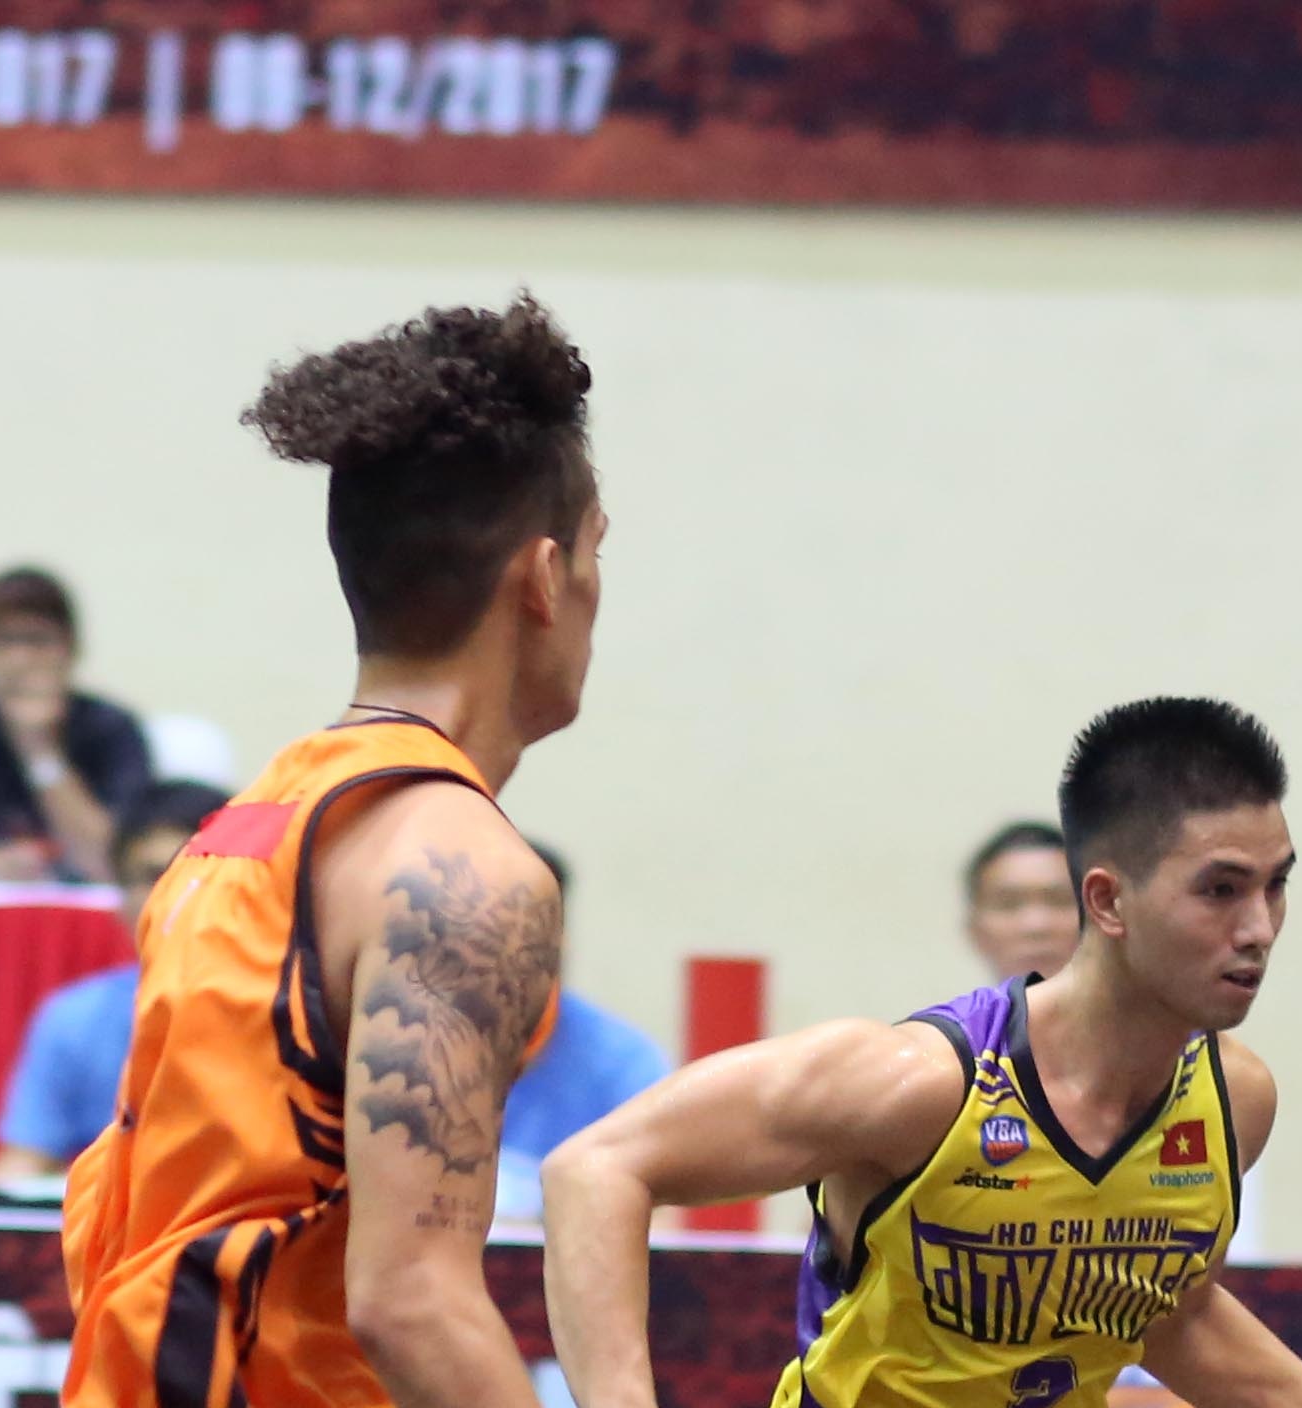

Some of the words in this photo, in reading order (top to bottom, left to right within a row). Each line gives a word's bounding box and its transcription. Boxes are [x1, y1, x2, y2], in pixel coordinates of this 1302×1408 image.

[985, 1119, 1023, 1142] VBA
[998, 1221, 1036, 1246] HO
[1050, 1219, 1093, 1244] CHI
[1104, 1217, 1170, 1243] MINH
